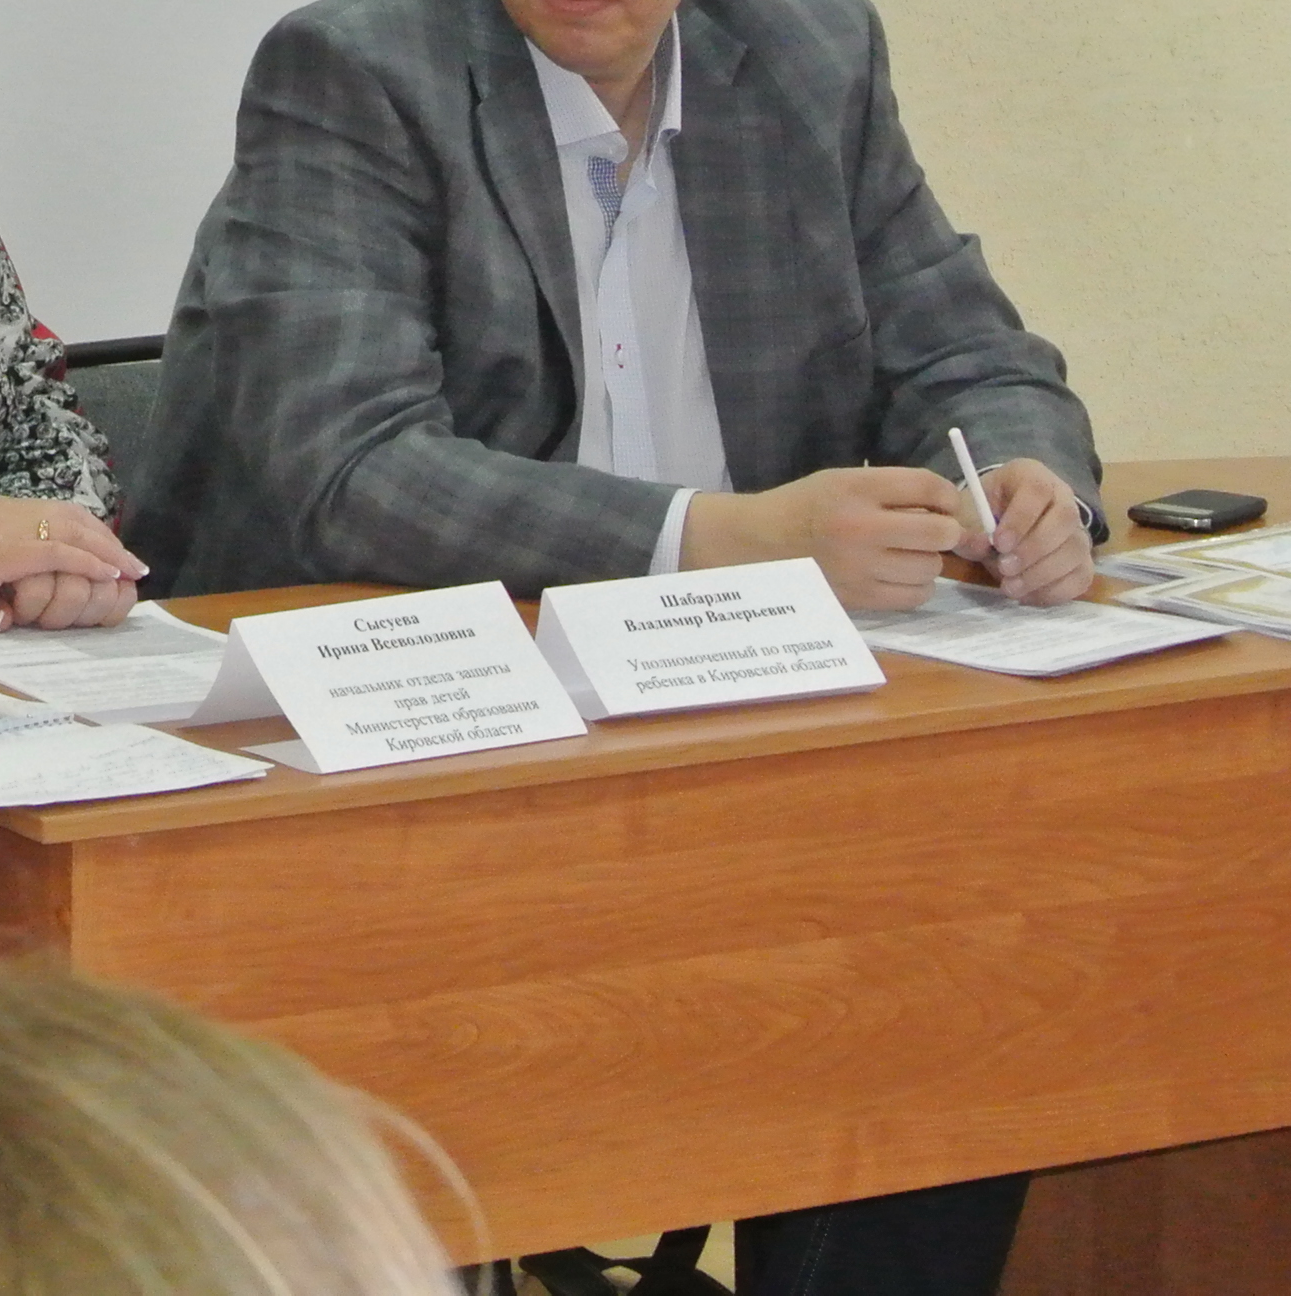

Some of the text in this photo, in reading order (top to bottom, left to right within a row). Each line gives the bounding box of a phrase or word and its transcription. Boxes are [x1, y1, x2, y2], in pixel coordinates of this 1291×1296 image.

[660, 589, 741, 609] Шабардин
[354, 613, 420, 633] Сысуева
[624, 603, 796, 633] Владимир Валерьевич
[318, 626, 476, 659] Ирина Всеволодовна
[627, 646, 758, 672] Уполномоченный
[783, 637, 833, 654] правам
[329, 662, 511, 698] начальник отдела защиты
[635, 673, 694, 693] ребенка
[708, 661, 788, 684] Кировской
[791, 654, 848, 673] области
[394, 688, 470, 711] прав детей
[345, 698, 539, 735] Министерства образования
[385, 722, 523, 753] Кировской области
